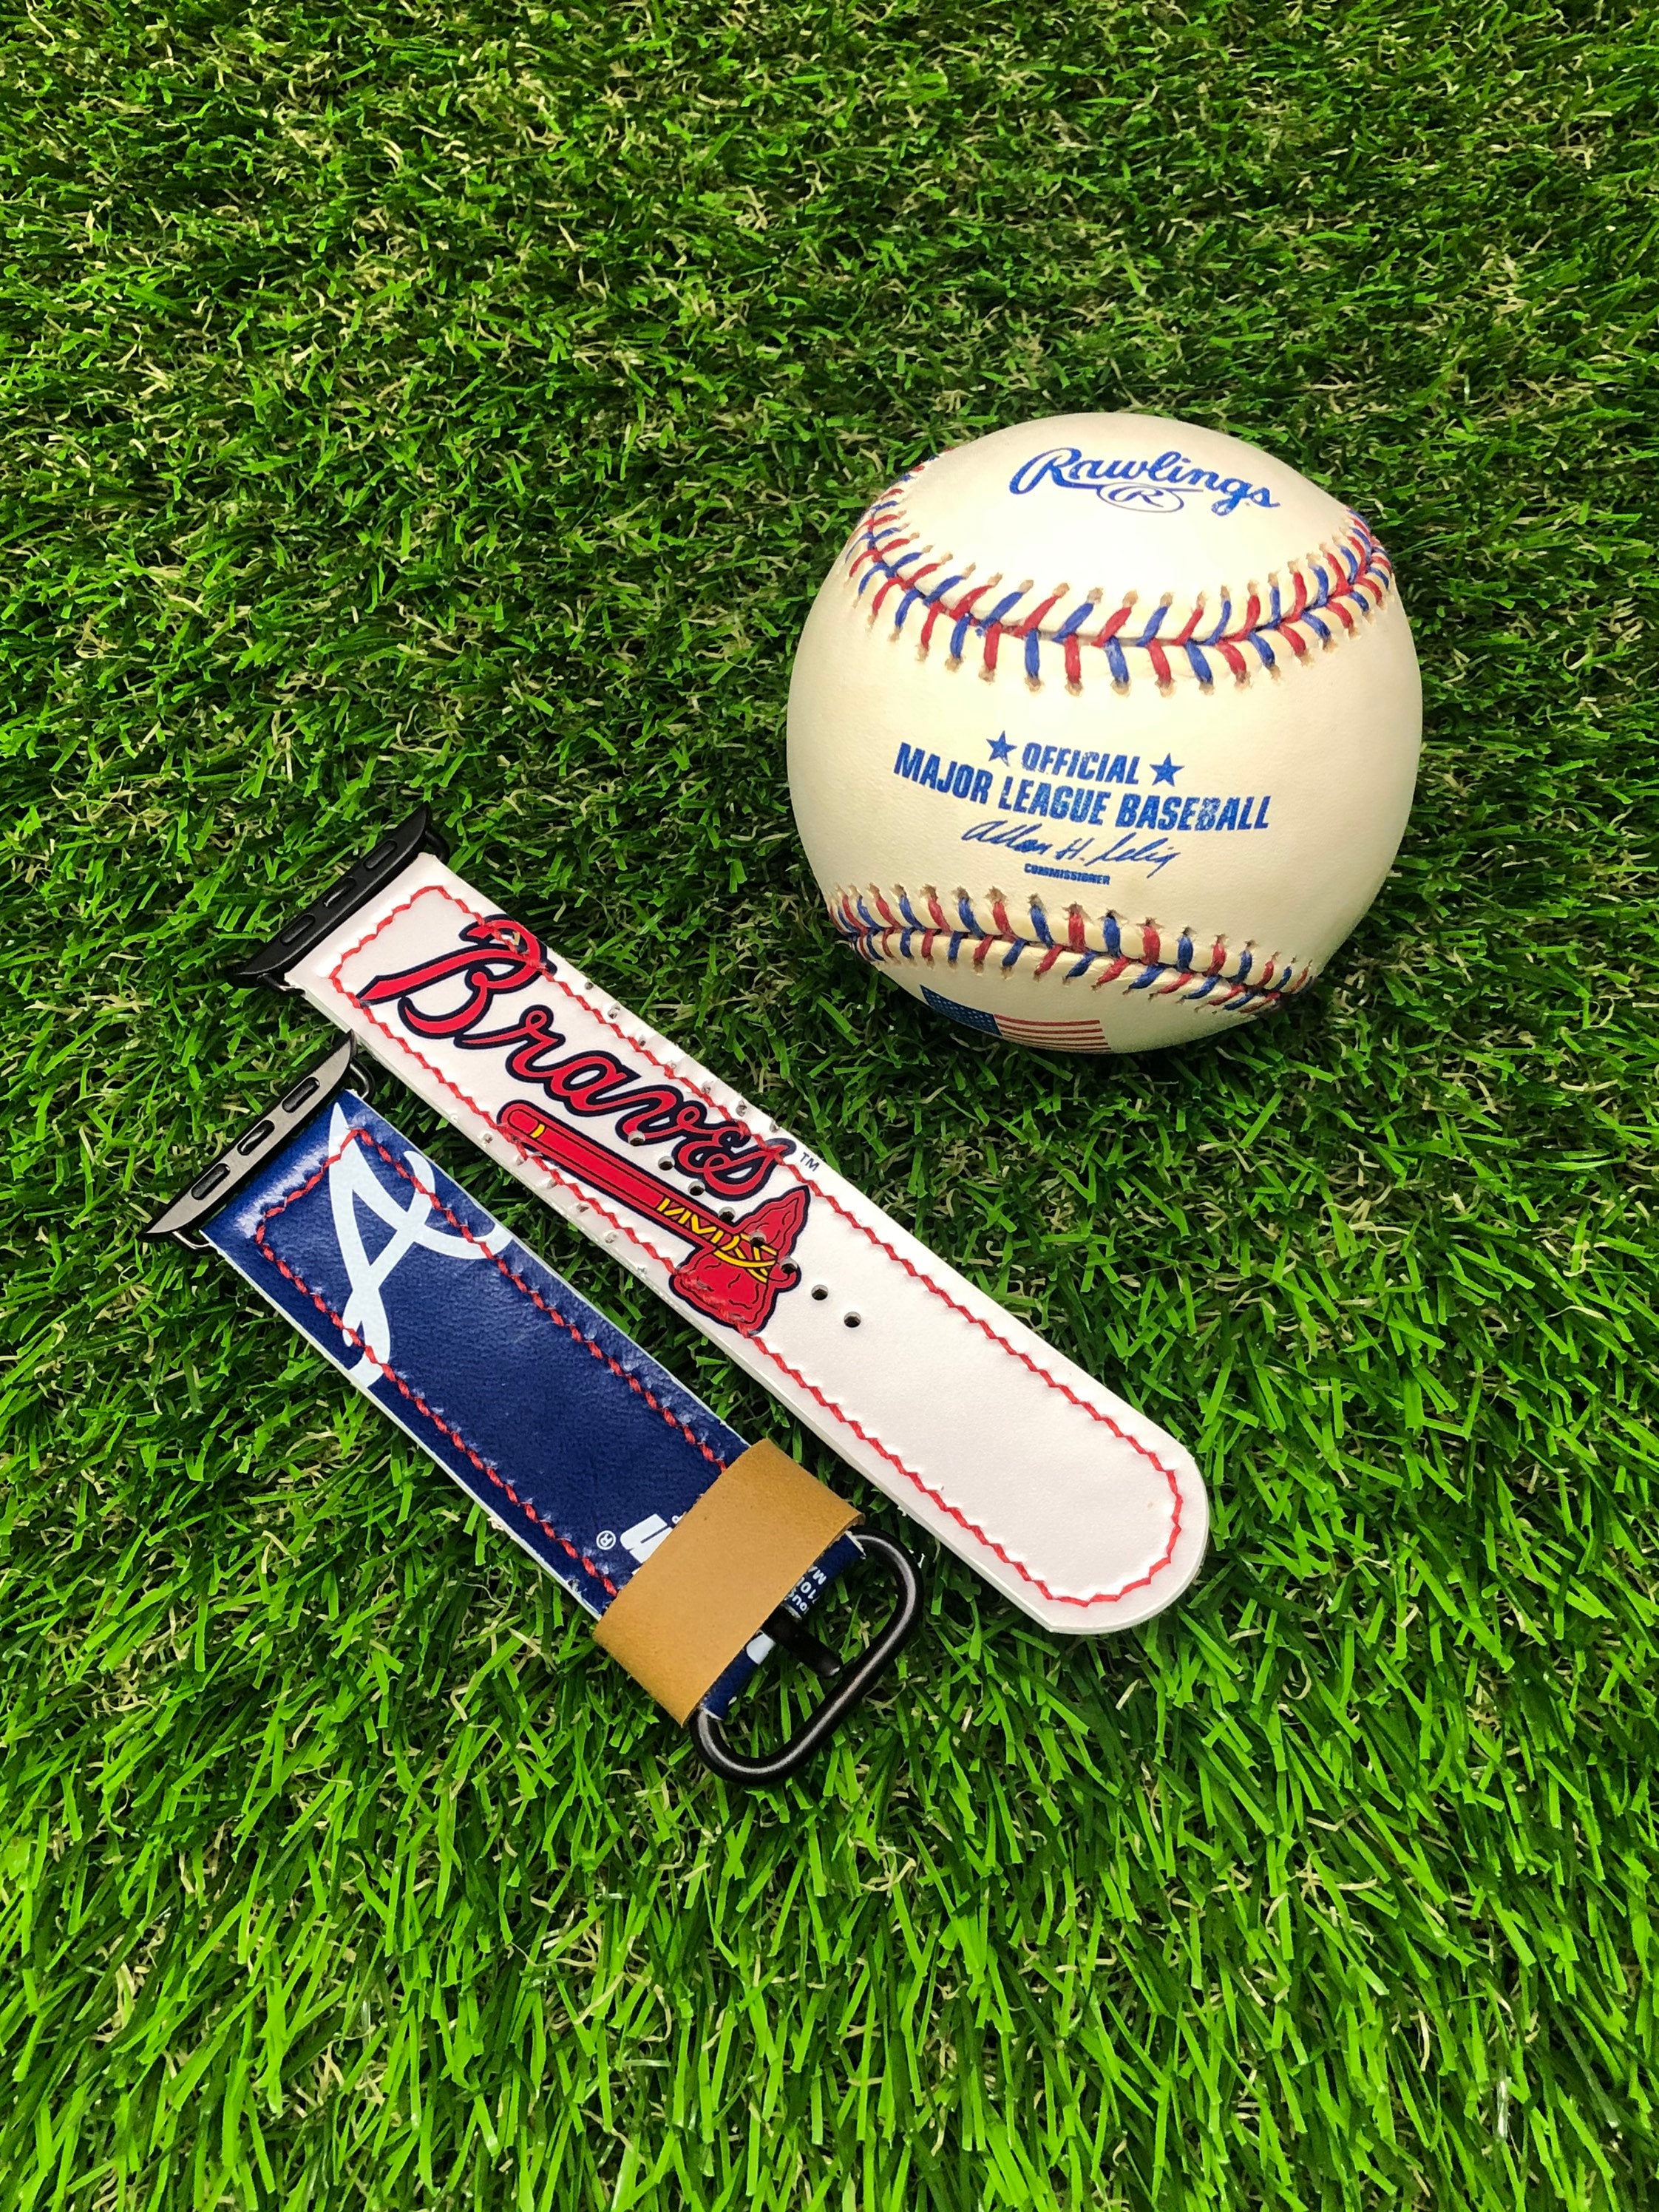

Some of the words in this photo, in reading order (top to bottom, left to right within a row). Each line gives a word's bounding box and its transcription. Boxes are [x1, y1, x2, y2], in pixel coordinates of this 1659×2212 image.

[1009, 447, 1280, 516] Rawlings
[893, 742, 993, 804] MAJOR
[998, 776, 1111, 826] LEAGUE
[1116, 793, 1271, 832] BASEBALL
[1022, 742, 1141, 785] OFFICIAL
[1024, 863, 1110, 885] COMMISSIONER
[356, 914, 796, 1201] Braves
